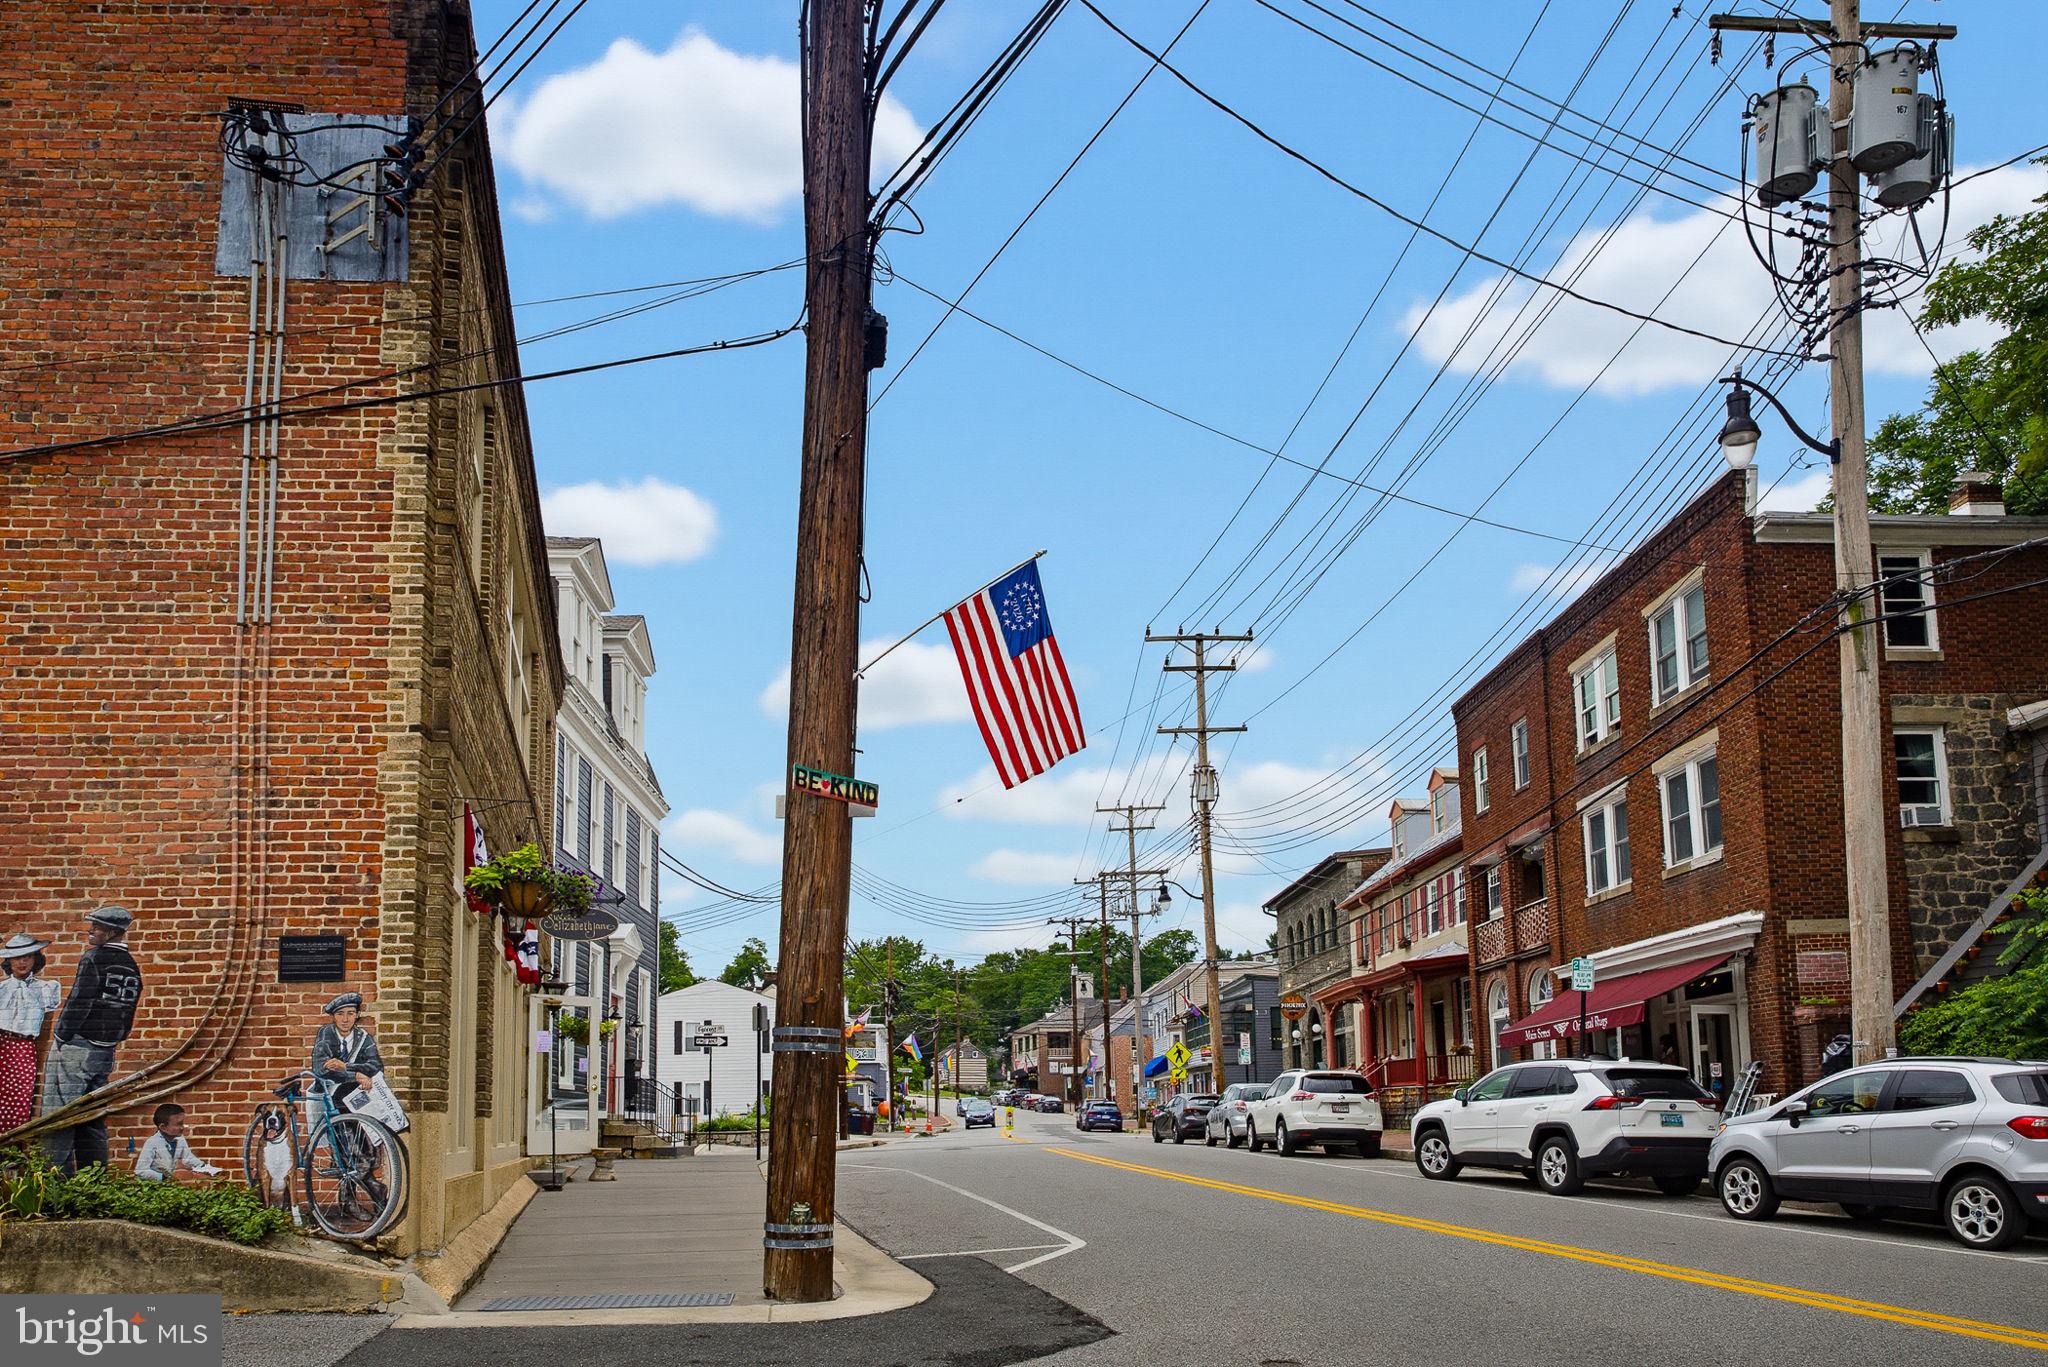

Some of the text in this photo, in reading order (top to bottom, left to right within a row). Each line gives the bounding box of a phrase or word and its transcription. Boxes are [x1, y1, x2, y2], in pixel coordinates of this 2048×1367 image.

[795, 767, 878, 803] BE KIND
[102, 972, 139, 1002] 58
[1525, 1029, 1537, 1041] Main
[1594, 1015, 1608, 1030] Rugs
